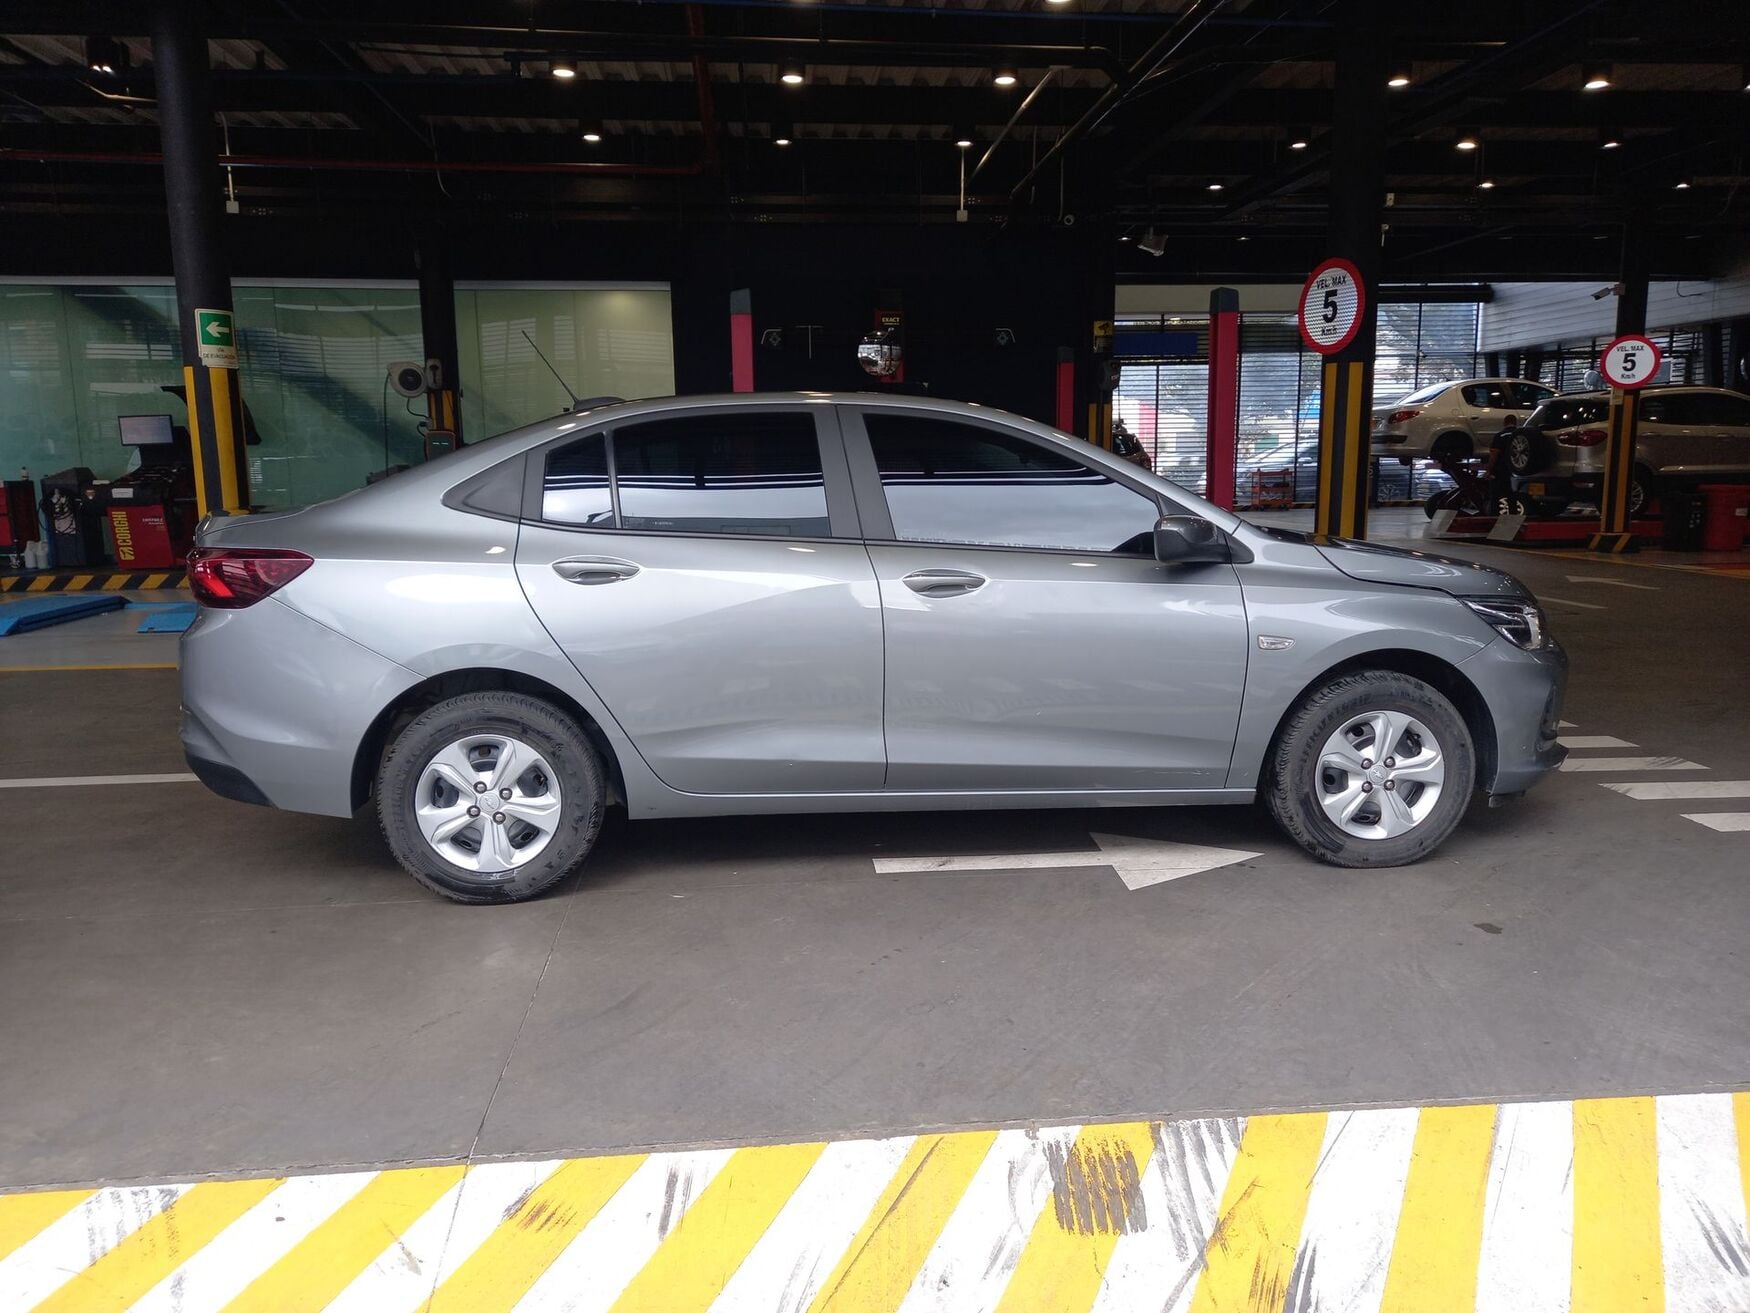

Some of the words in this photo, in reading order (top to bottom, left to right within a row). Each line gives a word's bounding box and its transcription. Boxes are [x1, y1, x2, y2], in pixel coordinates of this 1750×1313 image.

[1332, 275, 1347, 287] MAX
[1322, 289, 1338, 324] 5
[1622, 352, 1637, 372] 5
[111, 511, 132, 546] CORGHI
